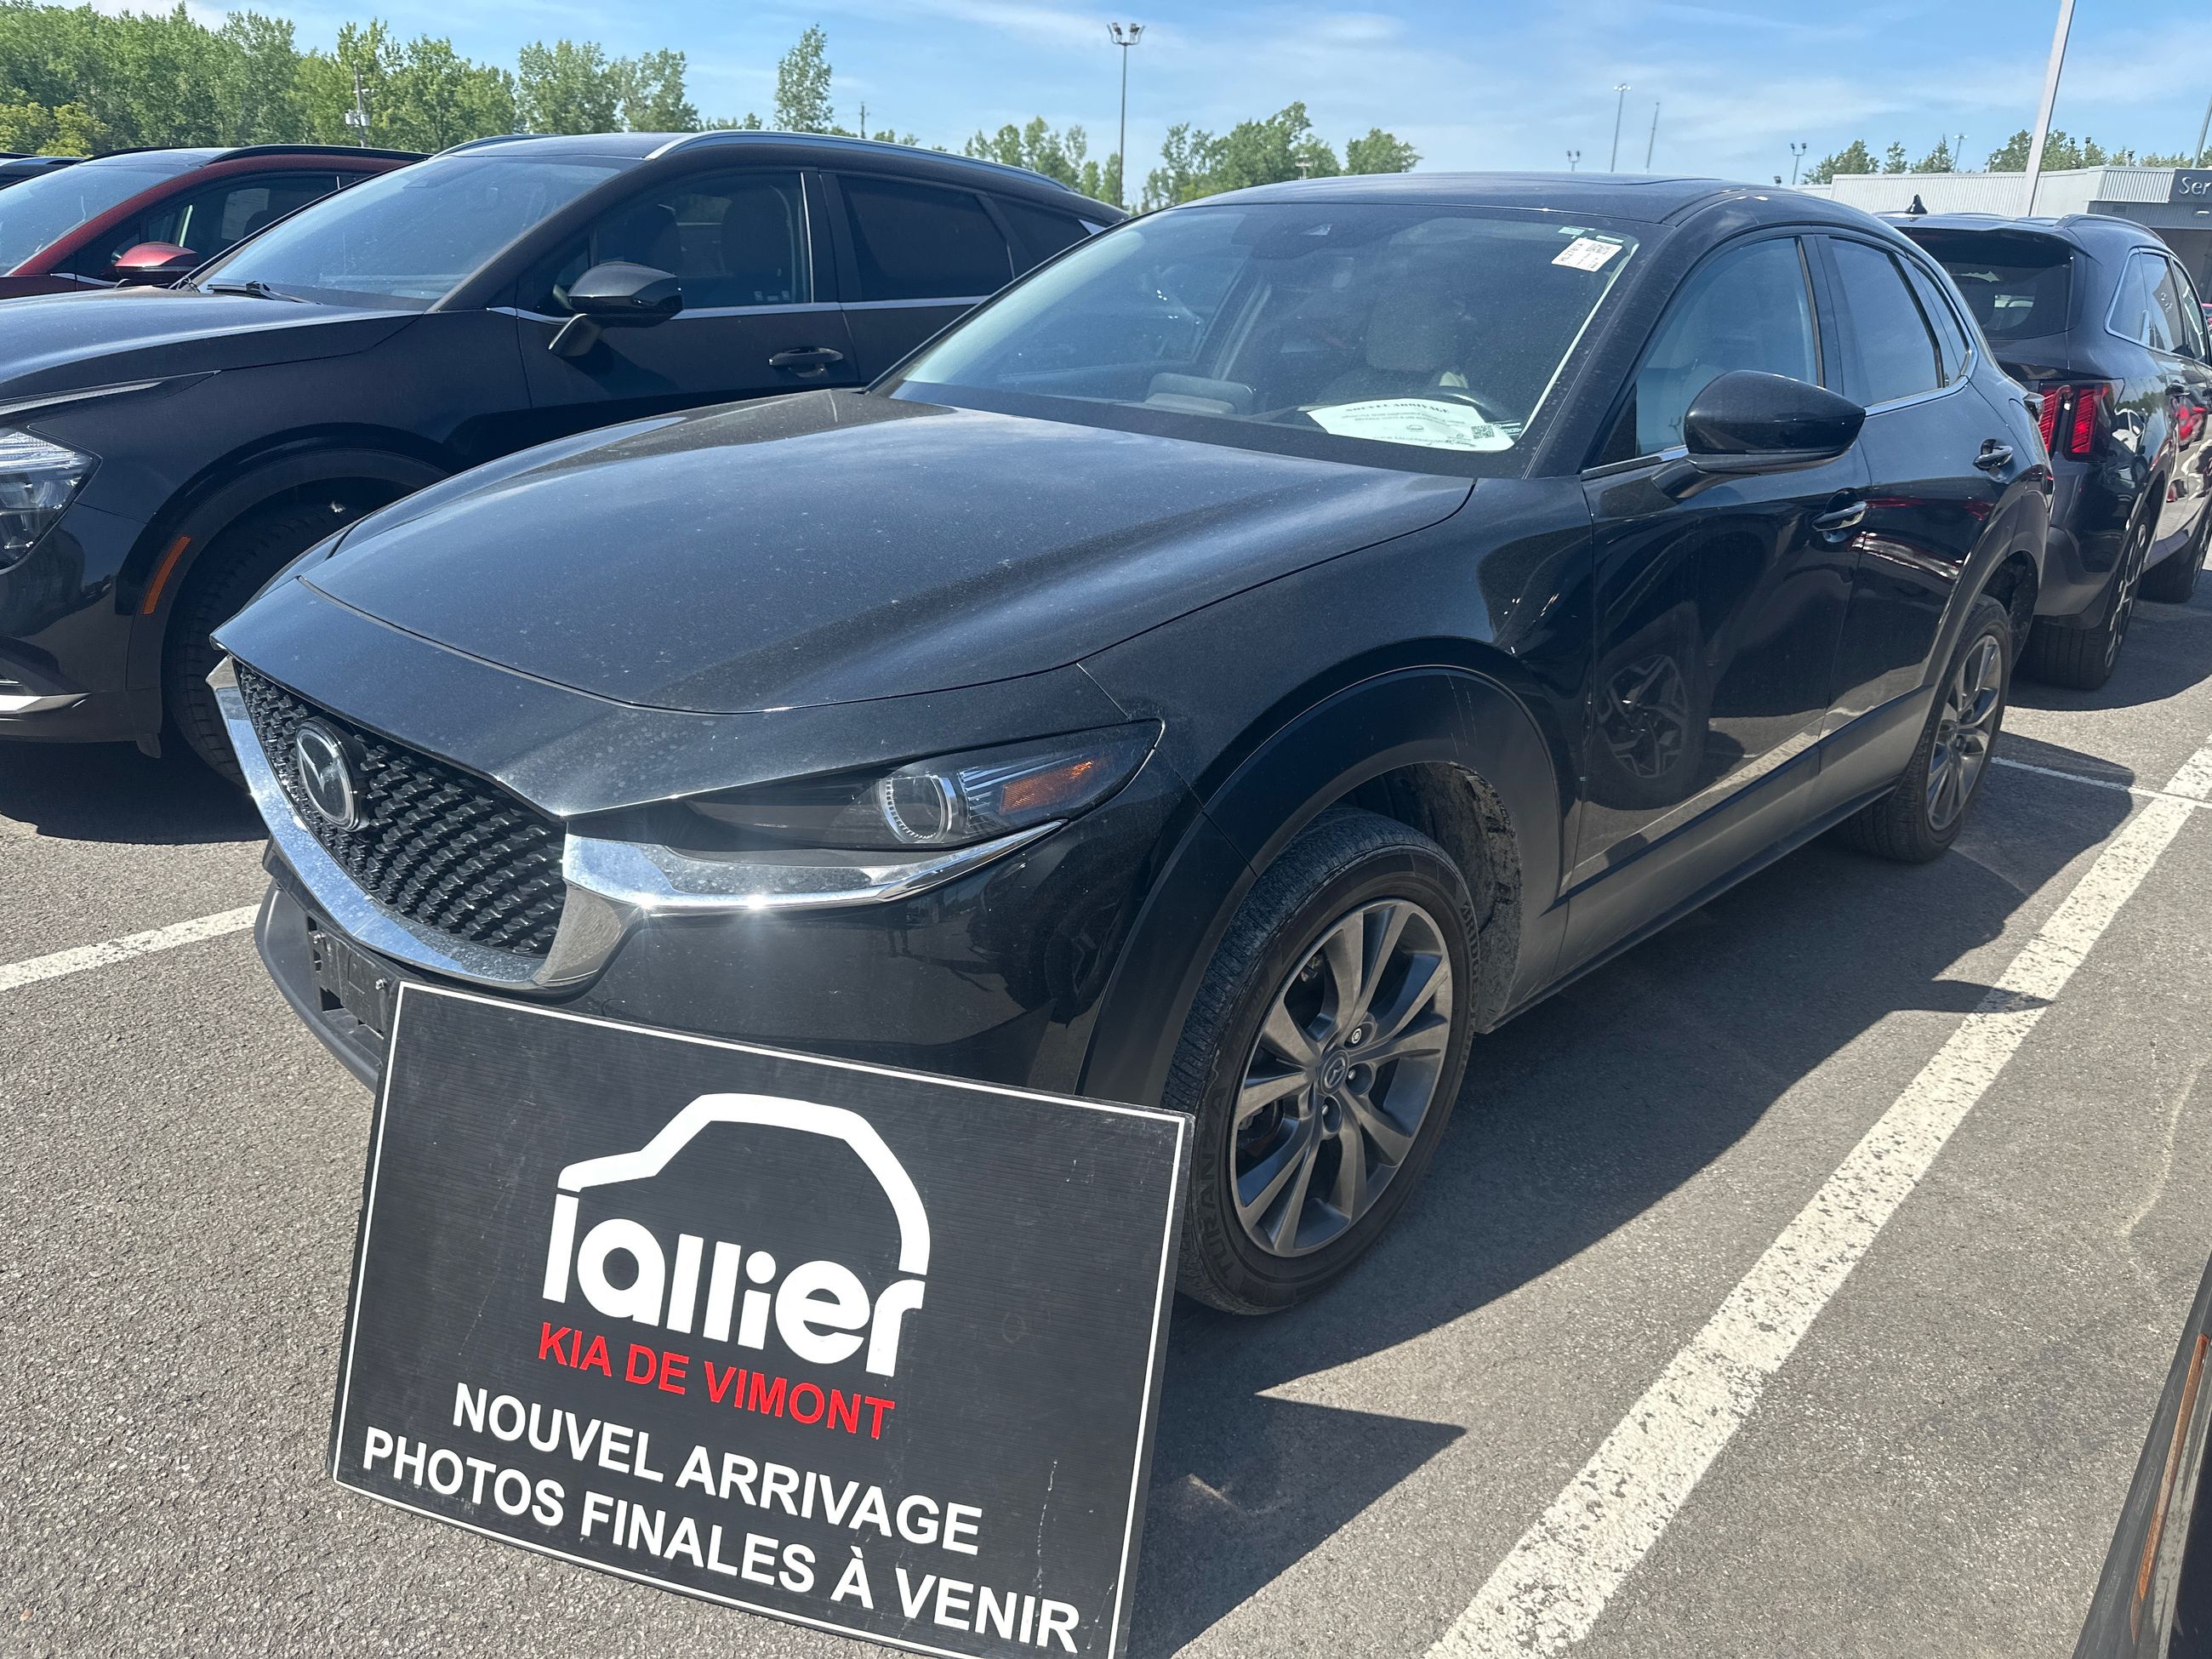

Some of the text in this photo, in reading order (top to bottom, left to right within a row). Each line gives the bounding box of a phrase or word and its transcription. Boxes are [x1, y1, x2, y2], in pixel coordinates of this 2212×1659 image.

[538, 1321, 896, 1440] KIA DE VIMONT
[362, 1426, 1080, 1654] PHOTOS FINALES À VENIR
[453, 1382, 983, 1556] NOUVEL ARRIVAGE
